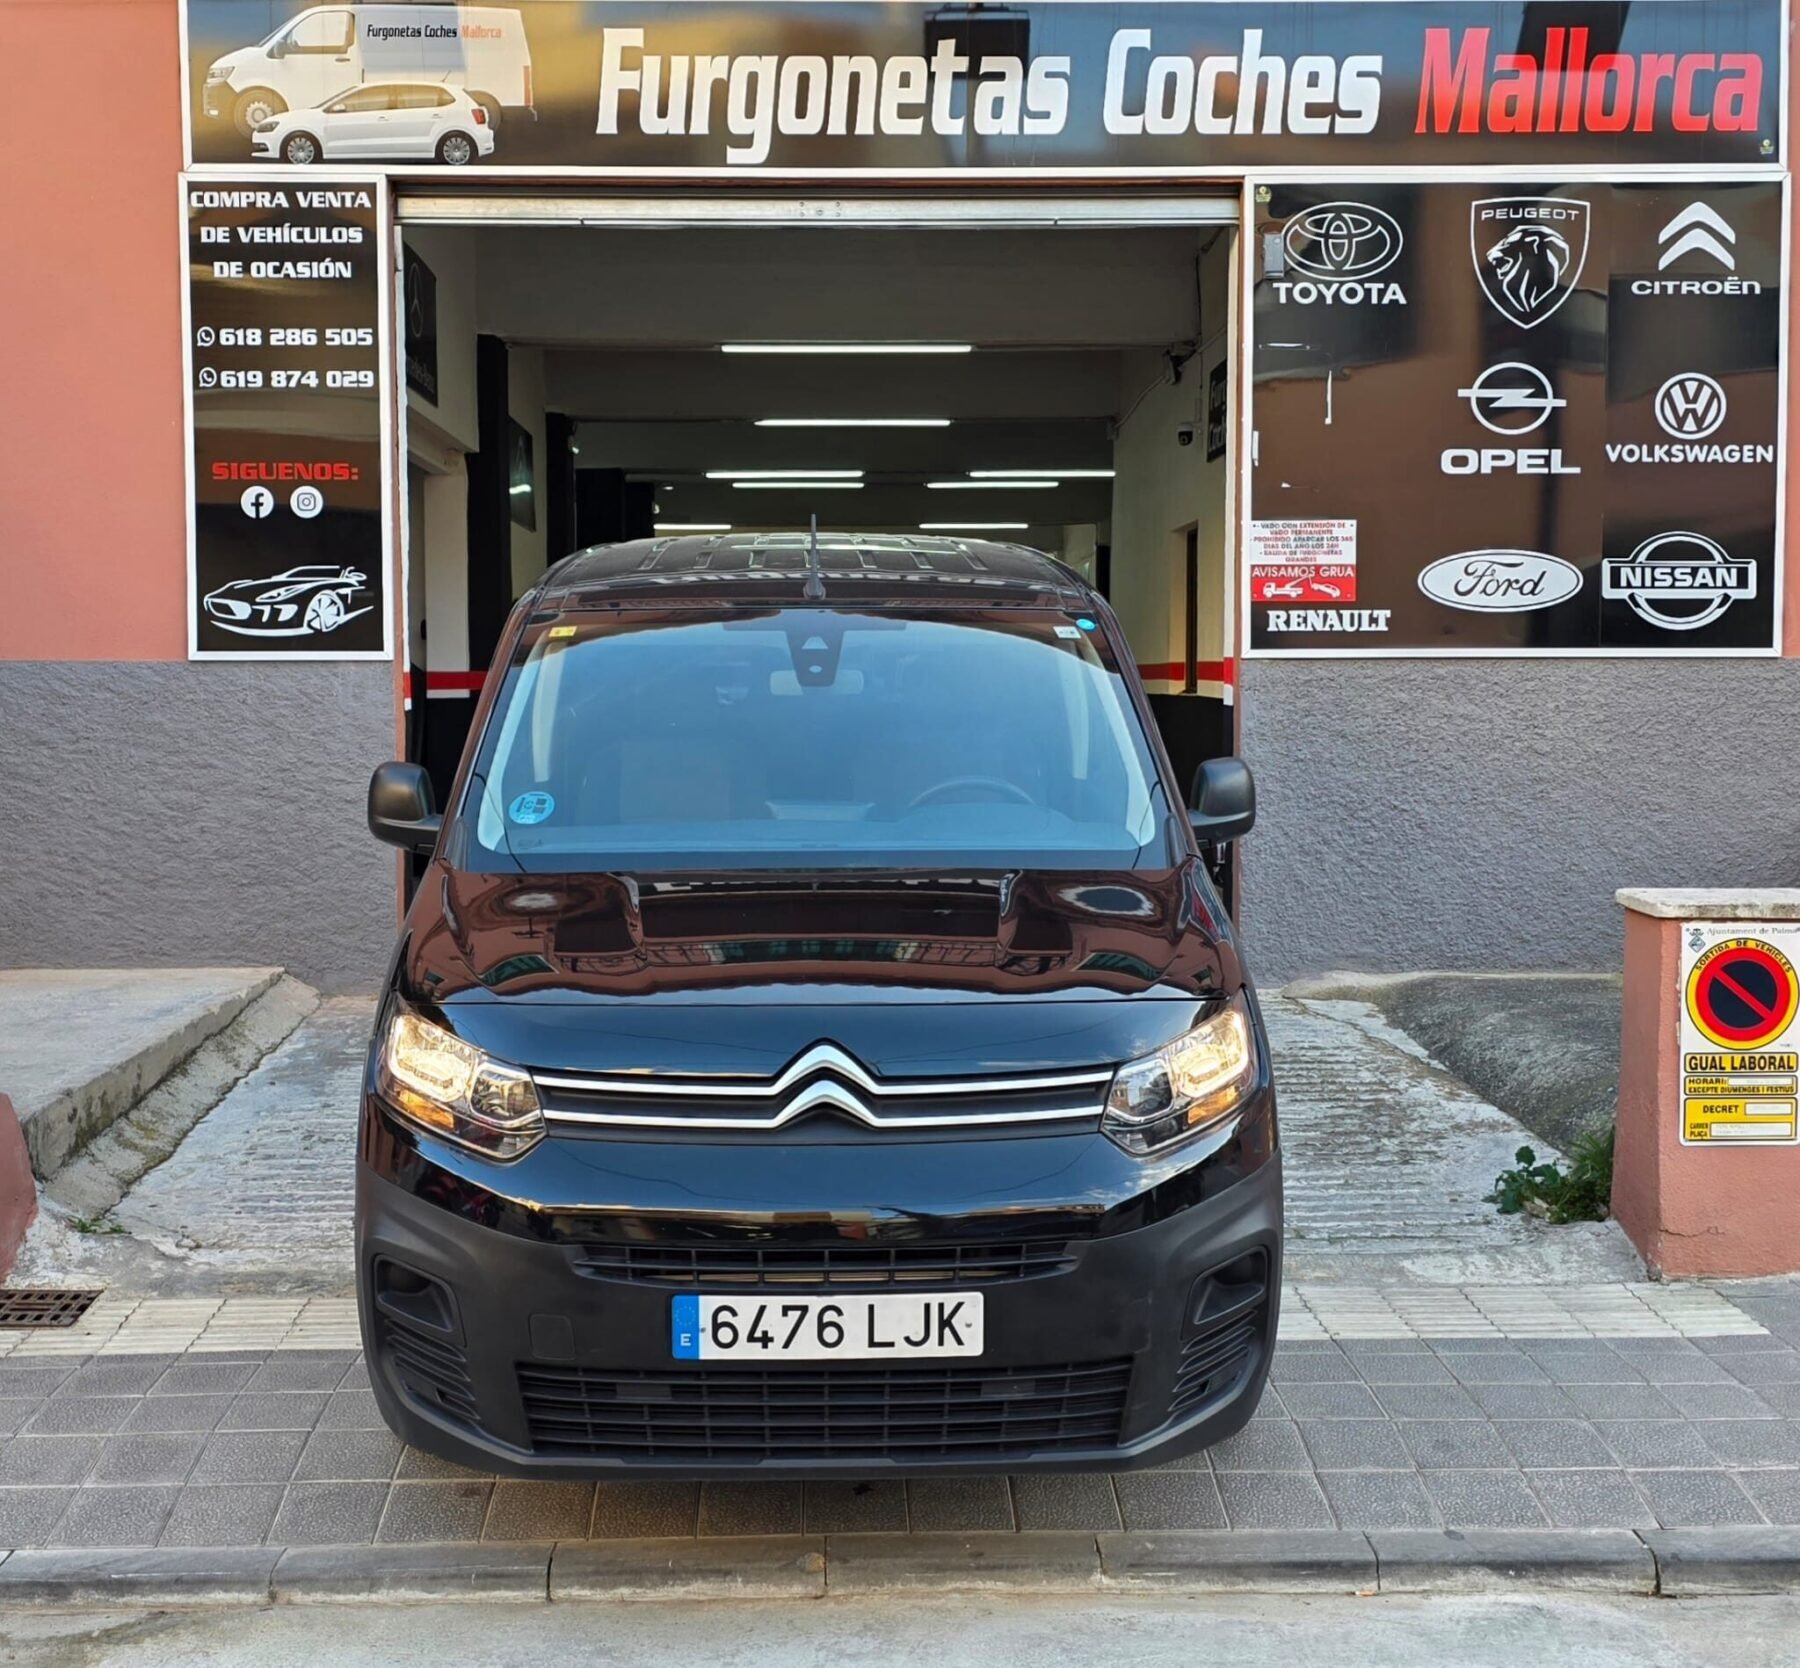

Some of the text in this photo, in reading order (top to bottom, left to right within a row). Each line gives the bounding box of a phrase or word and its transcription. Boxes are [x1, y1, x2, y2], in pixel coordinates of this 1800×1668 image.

[367, 24, 503, 40] Furgonetas Coches Mallorca
[595, 27, 1764, 164] Furgonetas Coches Mallorca
[190, 191, 371, 208] COMPRA VENTA
[1481, 208, 1580, 221] PEUGEOT
[200, 223, 363, 244] DE VEHÍCULOS
[213, 258, 352, 278] DE OCASIÓN
[1273, 282, 1407, 304] TOYOTA
[219, 328, 373, 346] 618 286 505
[220, 370, 374, 388] 619 874 029
[1440, 449, 1581, 474] OPEL
[1605, 444, 1774, 463] VOLKSWAGEN
[211, 462, 359, 480] SIGUENOS:
[1252, 566, 1354, 577] AVISAMOS GRUA
[1454, 560, 1547, 600] Ford
[1619, 566, 1738, 588] NISSAN
[1266, 609, 1391, 632] RENAULT
[1707, 927, 1756, 935] Ajuntament
[1695, 943, 1730, 970] SORTIDA
[1755, 941, 1792, 973] VEHICLES
[1689, 1055, 1794, 1071] GUAL LABORAL
[1703, 1105, 1739, 1113] DECRET
[711, 1301, 965, 1349] 6476 LJK
[680, 1334, 692, 1346] E
